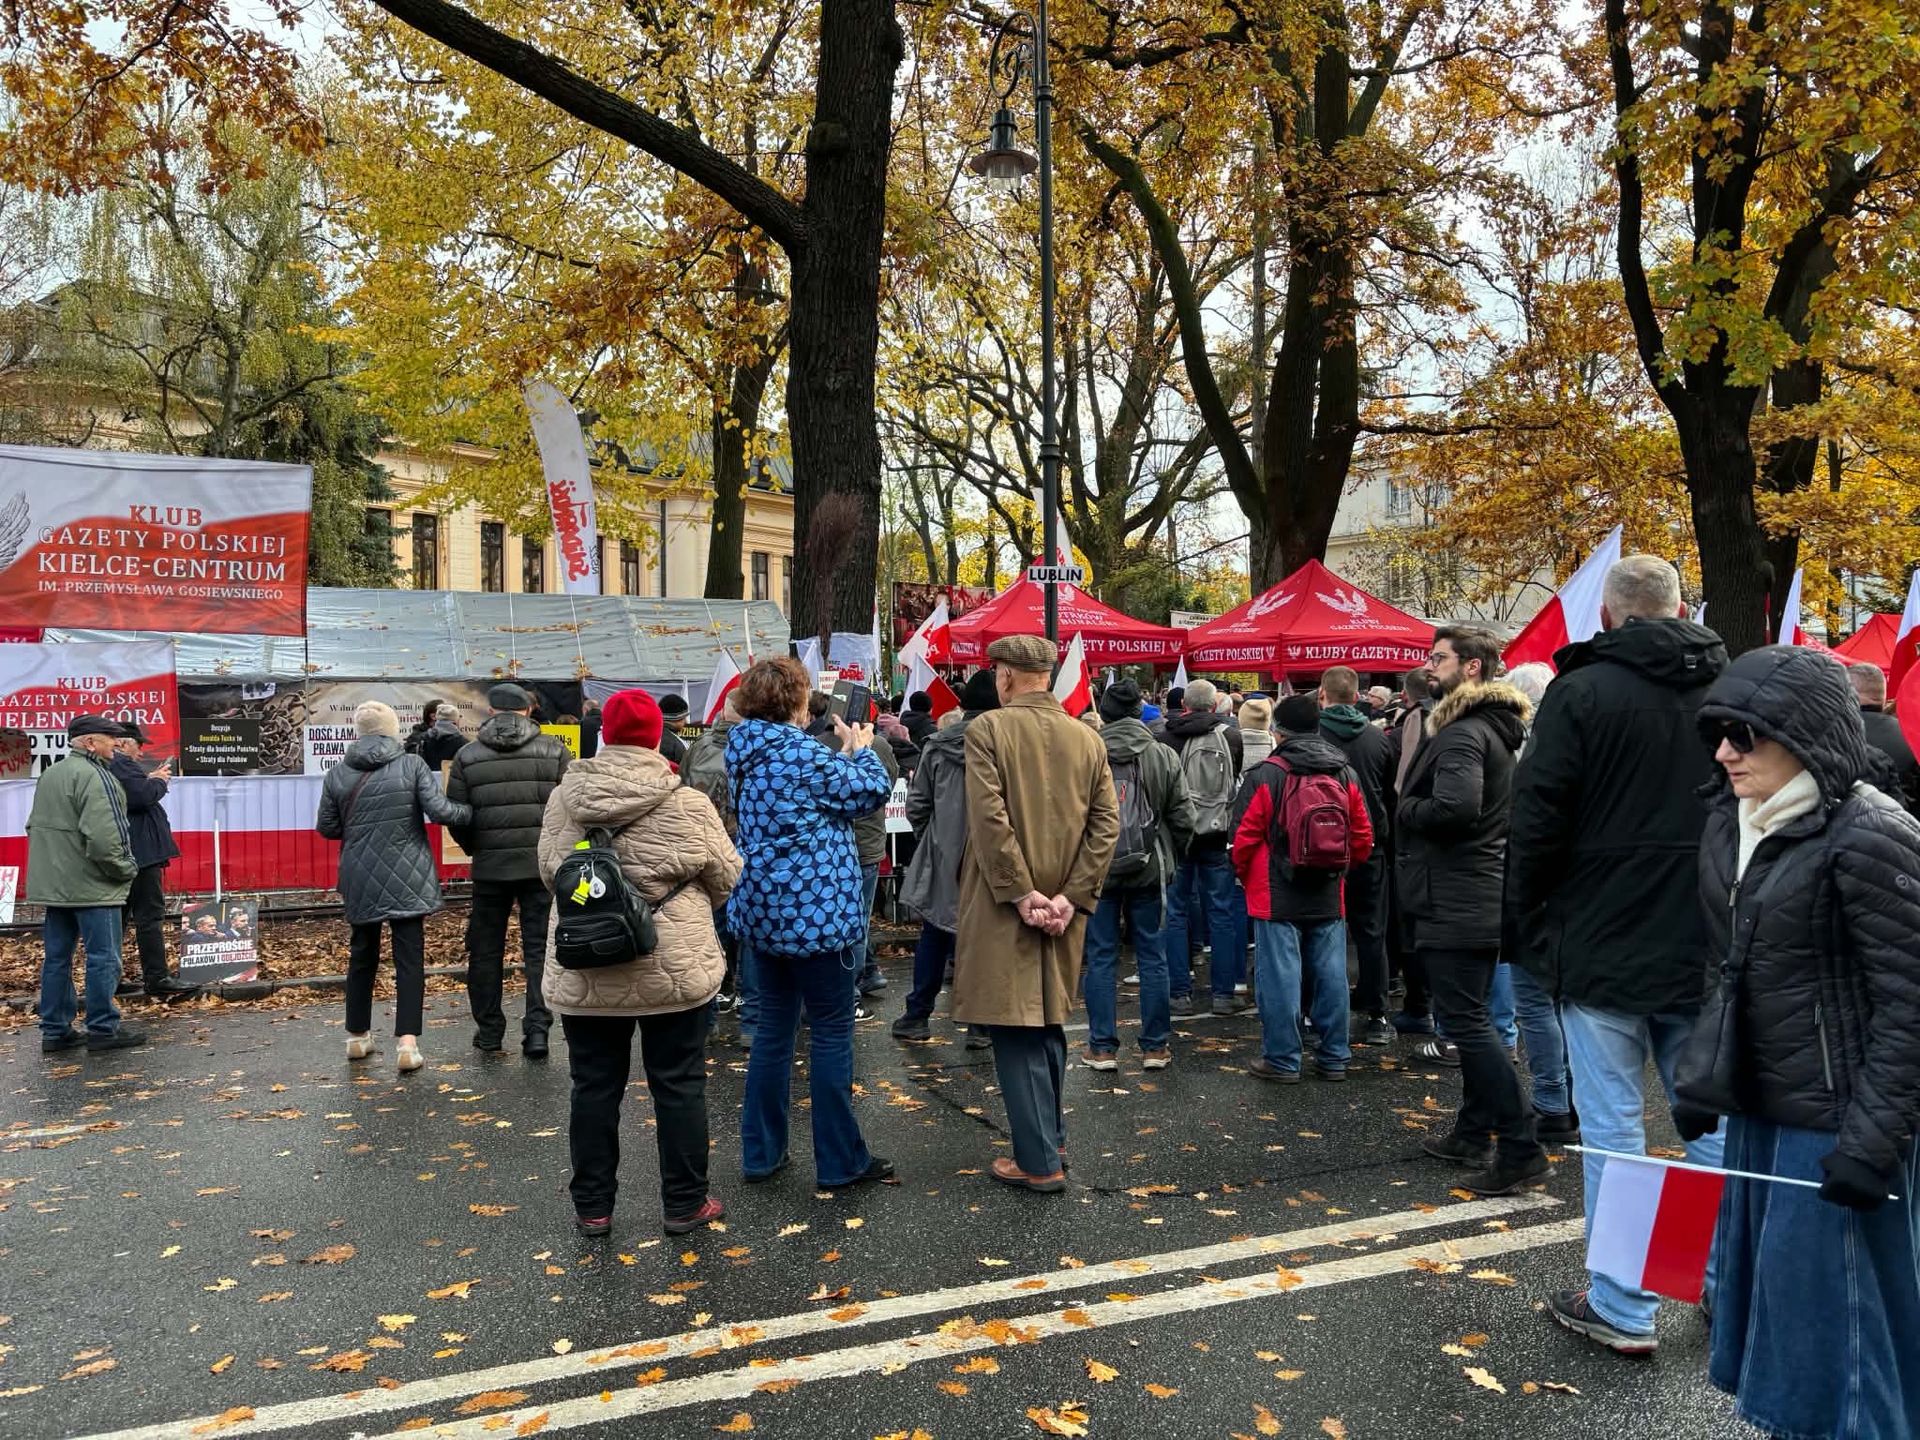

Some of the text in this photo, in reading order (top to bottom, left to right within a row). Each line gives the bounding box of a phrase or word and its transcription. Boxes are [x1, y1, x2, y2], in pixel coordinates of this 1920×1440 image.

[129, 504, 203, 527] KLUB
[38, 526, 286, 558] GAZETY POLSKIEJ
[38, 552, 286, 582] KIELCE-CENTRUM
[1029, 568, 1083, 582] LUBLIN
[38, 580, 283, 601] IM. PRZEMYSŁAWA GOSIEWSKIEGO
[1057, 639, 1166, 655] GAETY POLSKIEJ
[1193, 646, 1264, 662] GAZETY POLSKIEJ
[1305, 646, 1349, 659] KLUBY
[1352, 646, 1401, 661] GAZETY
[57, 676, 107, 690] KLUB
[0, 690, 166, 707] GAZETY POLSKIEJ
[101, 705, 166, 726] GÓRA
[308, 726, 333, 741] DOŚĆ
[313, 742, 345, 755] PRAWA
[187, 938, 254, 955] PRZEPROŚCIE
